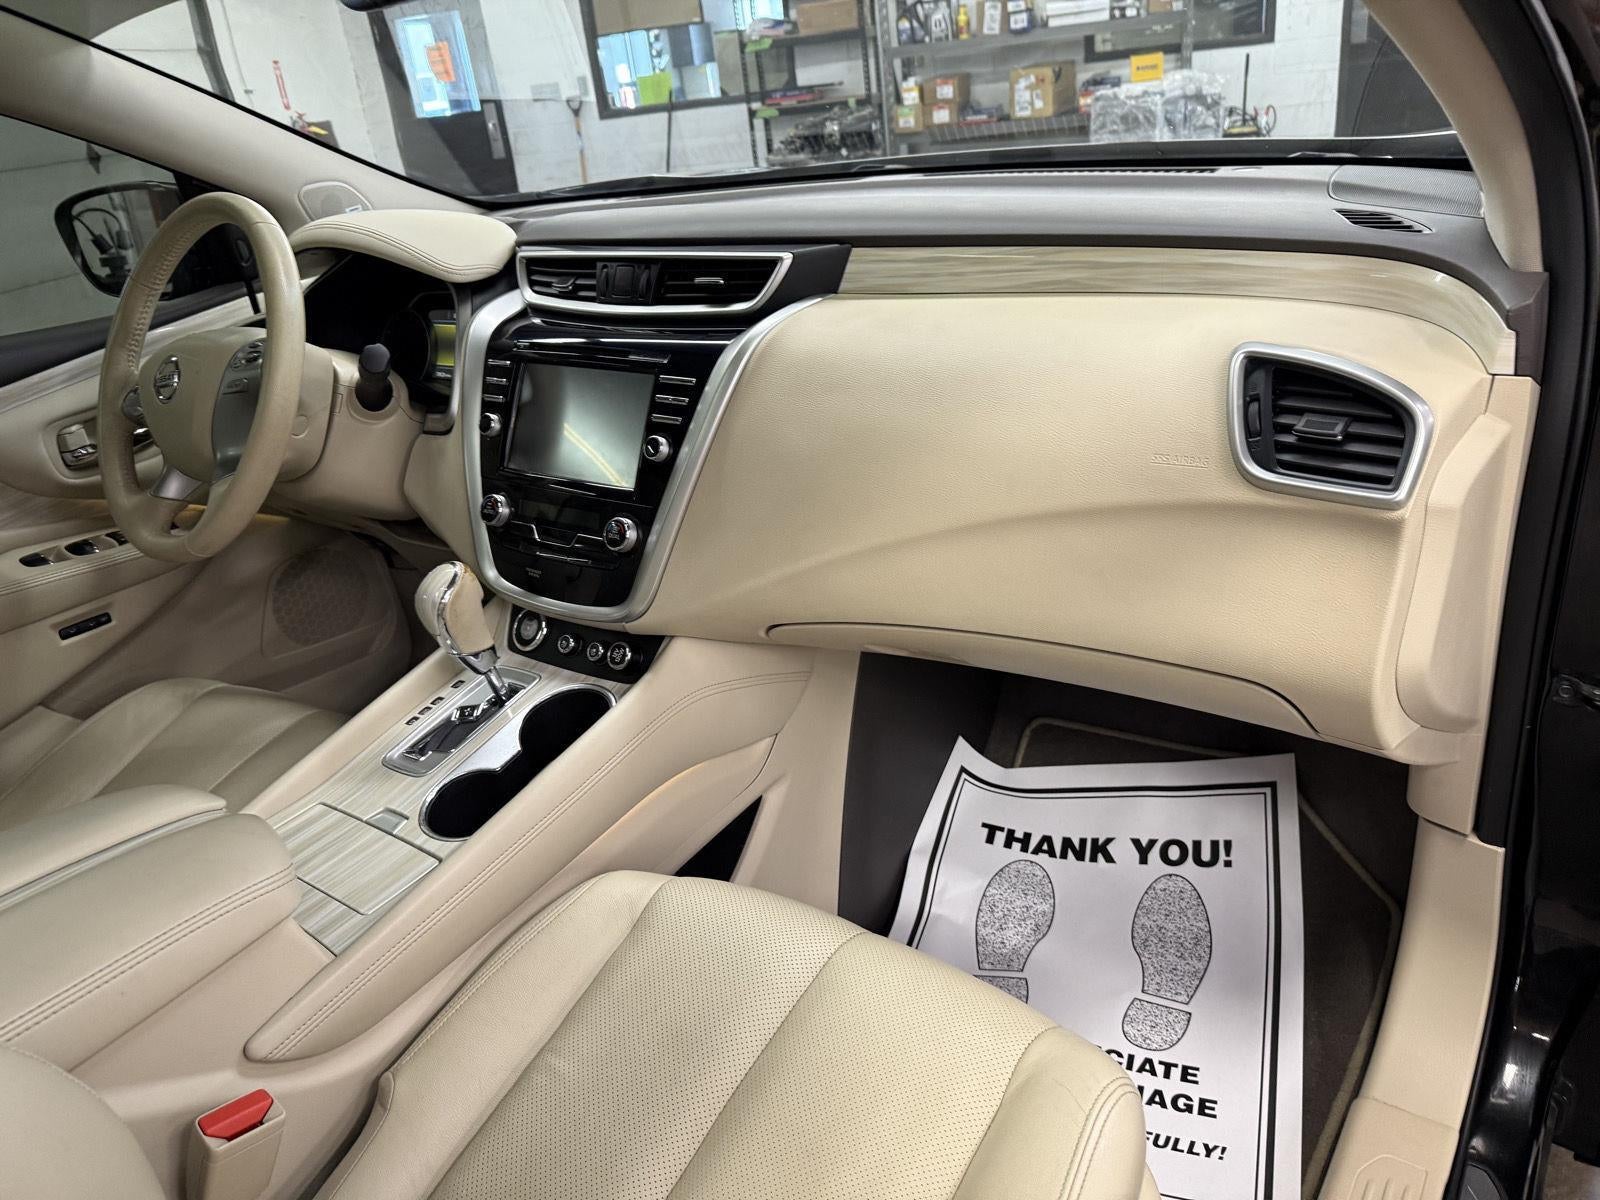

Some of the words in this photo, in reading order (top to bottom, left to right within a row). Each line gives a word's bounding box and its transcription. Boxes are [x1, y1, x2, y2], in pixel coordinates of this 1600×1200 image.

[981, 822, 1117, 864] THANK
[1129, 838, 1233, 868] YOU!
[1097, 1045, 1200, 1084] CIATE
